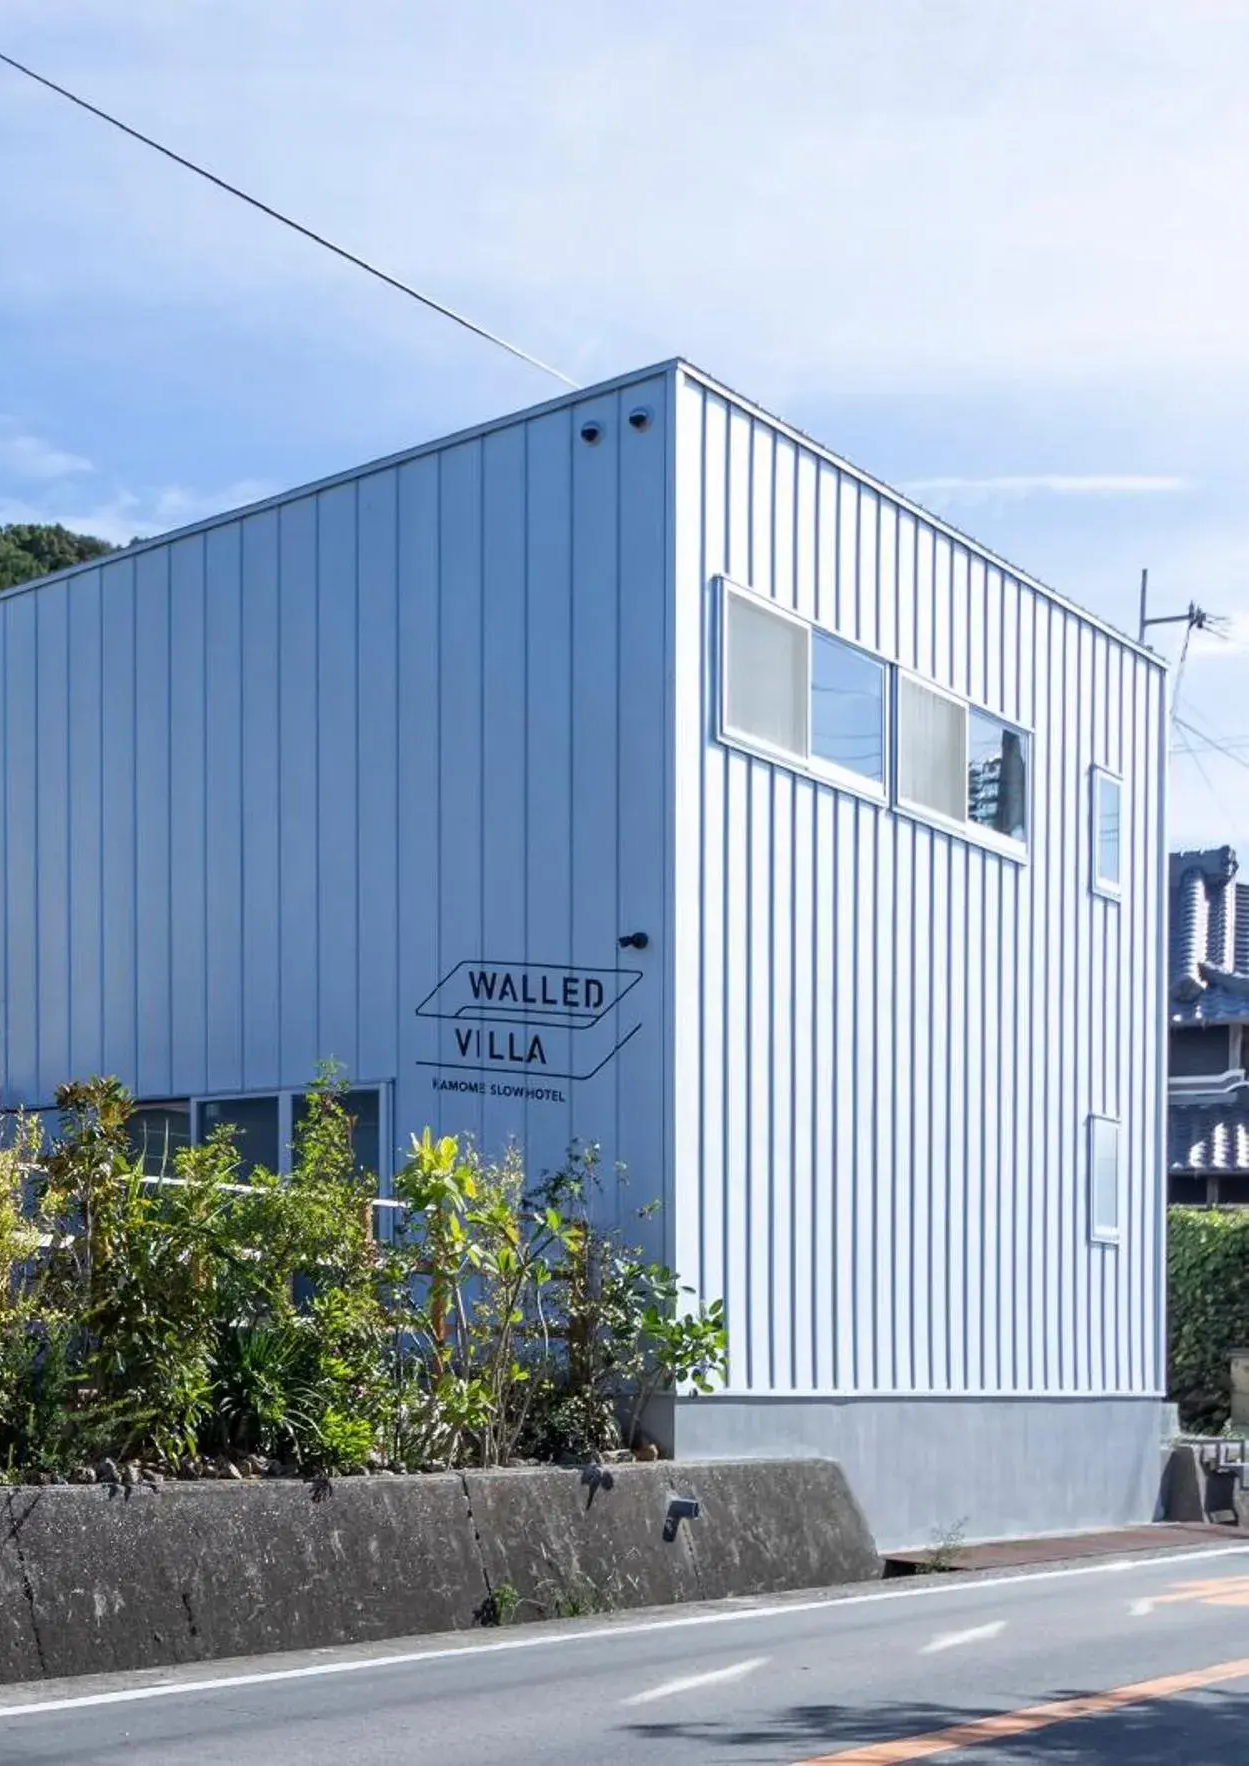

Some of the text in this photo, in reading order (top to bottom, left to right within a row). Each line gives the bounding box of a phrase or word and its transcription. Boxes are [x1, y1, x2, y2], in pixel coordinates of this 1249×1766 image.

[469, 971, 604, 1008] WALLED
[455, 1028, 547, 1064] VILLA
[432, 1078, 486, 1094] KAMOME
